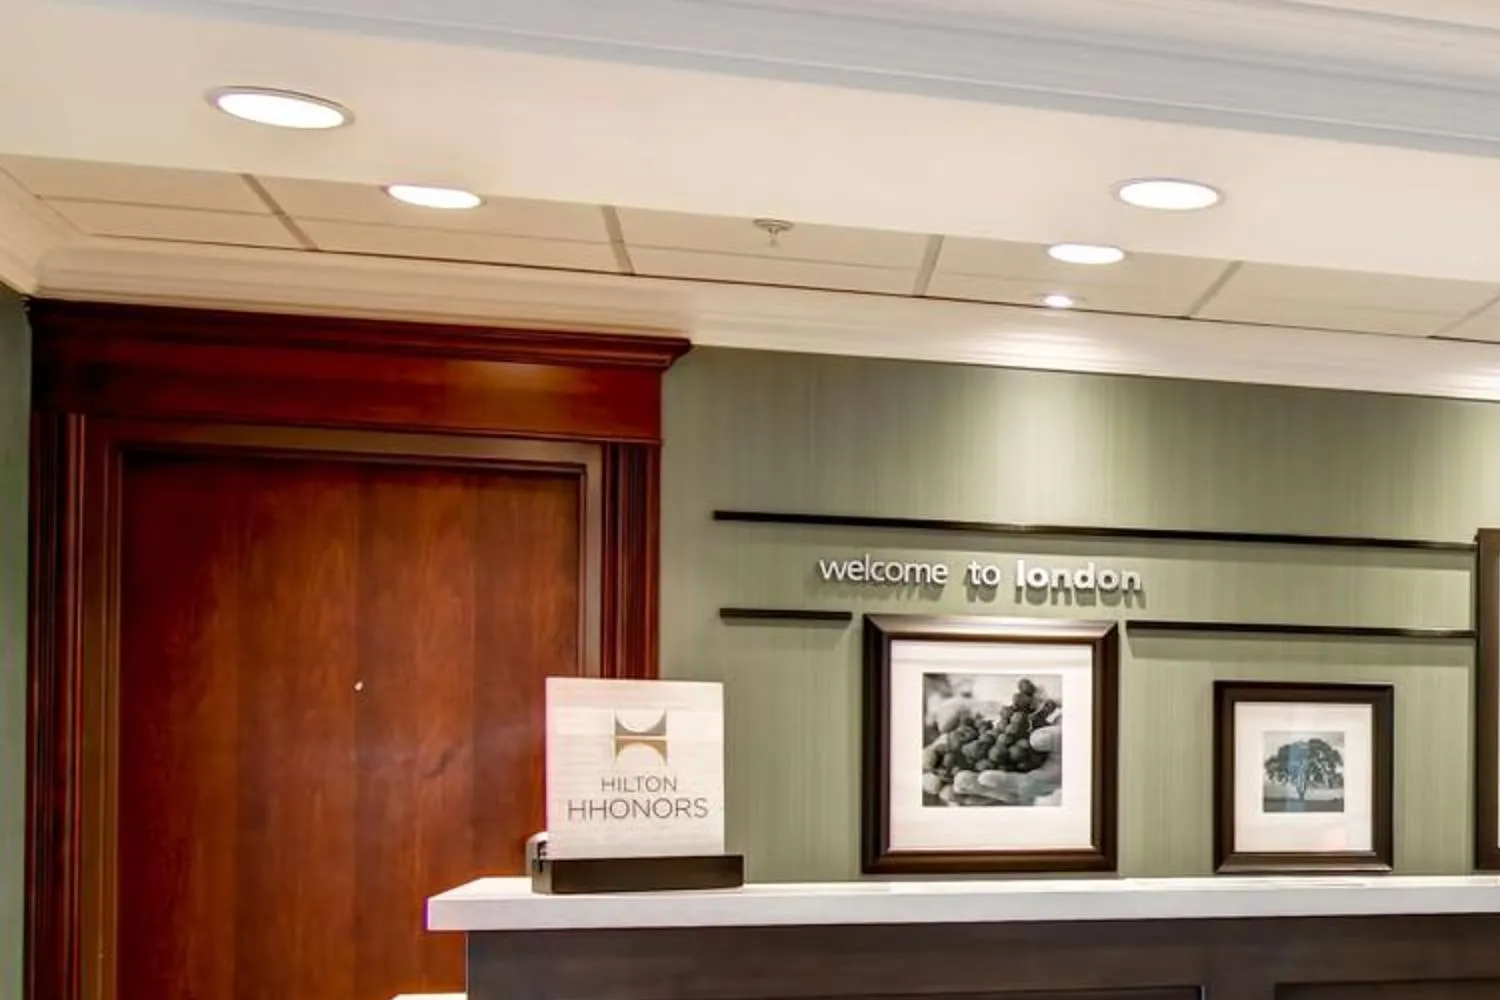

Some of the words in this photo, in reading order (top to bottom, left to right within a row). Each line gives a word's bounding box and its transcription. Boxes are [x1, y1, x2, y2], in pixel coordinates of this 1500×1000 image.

[818, 553, 949, 585] welcome
[966, 559, 1002, 586] to
[1016, 559, 1143, 591] london
[600, 775, 678, 793] HILTON
[567, 797, 709, 821] HHONORS
